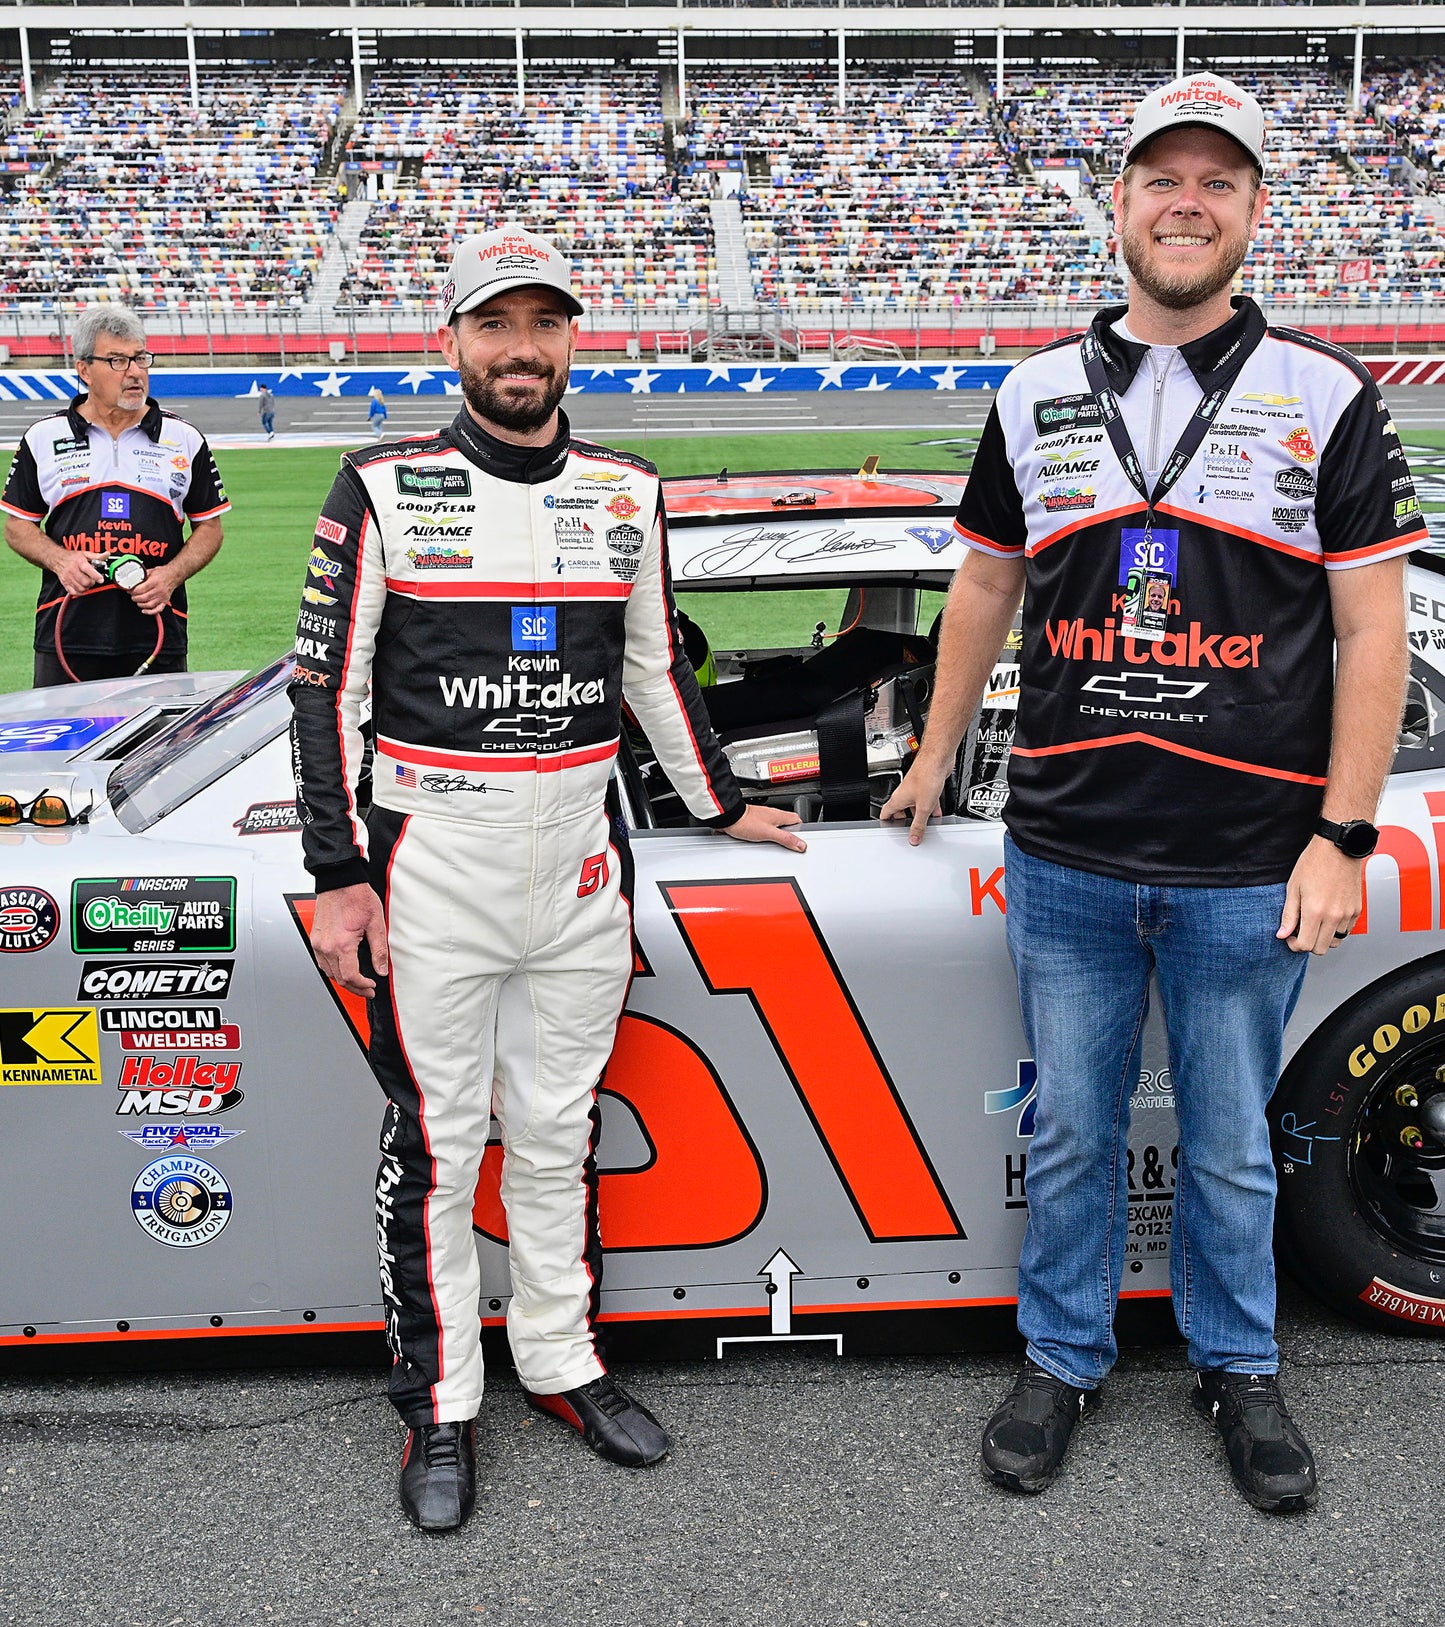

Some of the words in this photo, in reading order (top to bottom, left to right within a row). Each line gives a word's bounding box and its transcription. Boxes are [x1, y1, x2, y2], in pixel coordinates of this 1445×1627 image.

[1191, 80, 1216, 88] Kevin
[1160, 87, 1243, 111] Whitaker
[1174, 111, 1225, 119] CHEVROLET
[503, 235, 525, 243] Kevin
[478, 242, 550, 262] Whitaker
[1217, 340, 1241, 367] Whitaker
[1062, 394, 1084, 403] NASCAR
[1041, 406, 1077, 424] O'Reilly
[1077, 410, 1099, 418] PARTS
[1230, 406, 1305, 419] CHEVROLE
[1059, 422, 1076, 431] SERIES
[1209, 429, 1248, 437] Constructors
[1219, 423, 1238, 431] South
[1238, 424, 1267, 434] Electrical
[1034, 433, 1103, 451] GOODYEAR
[1288, 441, 1312, 450] STO
[423, 466, 446, 474] NASCAR
[1037, 459, 1100, 478] ALLIANCE
[1207, 464, 1235, 474] Fencing,
[1236, 466, 1251, 474] LLC
[403, 474, 442, 489] O'Reilly
[443, 480, 465, 488] PARTS
[1056, 493, 1096, 506] Weather
[1214, 488, 1255, 498] CAROLINA
[108, 498, 124, 509] SC
[396, 501, 476, 514] GOODYEAR
[98, 520, 132, 532] Kevin
[403, 525, 473, 537] ALLIANCE
[610, 532, 642, 541] RACING
[63, 532, 168, 558] Whitaker
[415, 553, 430, 565] All
[430, 553, 474, 565] Weather
[1134, 542, 1164, 567] SC
[300, 609, 337, 628] SPARTAN
[521, 617, 547, 635] SC
[1045, 617, 1264, 669] Whitaker
[508, 654, 560, 672] Kevin
[438, 672, 605, 710] Whitaker
[985, 695, 1016, 704] FILTE
[1079, 704, 1208, 722] CHEVROLET
[977, 728, 1015, 741] MatM
[481, 740, 574, 751] CHEVROLET
[984, 743, 1011, 756] Desig
[292, 738, 306, 804] Whitaker
[772, 760, 820, 773] BUTLERBU
[973, 790, 1010, 802] RACI
[248, 807, 298, 821] ROWD
[576, 851, 610, 898] 51
[137, 879, 189, 891] NASCAR
[0, 891, 48, 912] ASCAR
[182, 902, 221, 915] AUTO
[0, 914, 37, 925] 250
[88, 901, 172, 930] O'Reilly
[177, 915, 224, 930] PARTS
[0, 926, 50, 948] LUTES
[133, 940, 176, 952] SERIES
[83, 968, 229, 994] COMETIC
[106, 1010, 215, 1029] LINCOLN
[131, 1033, 227, 1048] WELDERS
[2, 1068, 98, 1082] KENNAMETAL
[119, 1056, 242, 1095] Holley
[117, 1090, 224, 1115] MSD
[142, 1126, 179, 1138] FIVE
[183, 1126, 221, 1138] STAR
[142, 1160, 220, 1188] CHAMPION
[1127, 1205, 1173, 1222] EXCAVA
[142, 1213, 223, 1243] IRRIGATION
[1146, 1241, 1167, 1252] MD
